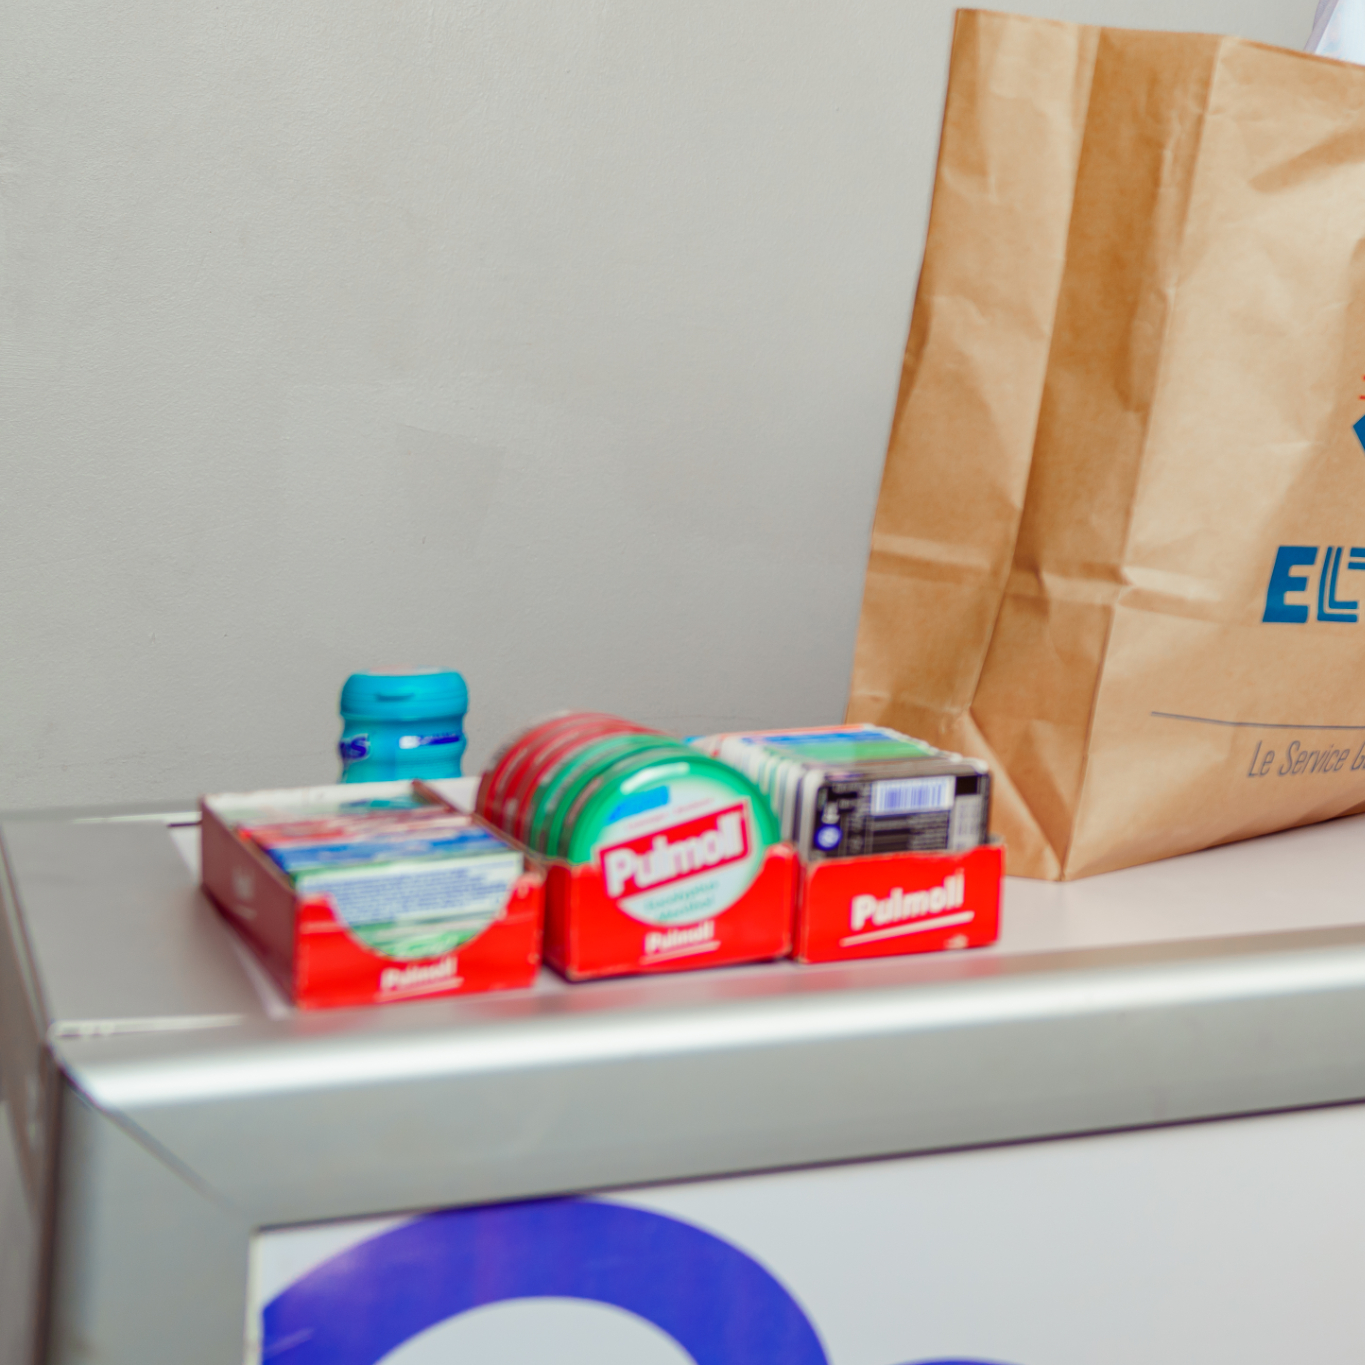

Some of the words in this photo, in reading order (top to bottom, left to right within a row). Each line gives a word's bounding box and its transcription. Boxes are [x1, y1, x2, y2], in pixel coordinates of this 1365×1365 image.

[1247, 740, 1275, 777] Le
[1277, 740, 1351, 776] Service
[603, 808, 745, 899] Pulmoll
[851, 867, 966, 931] Pulmoll
